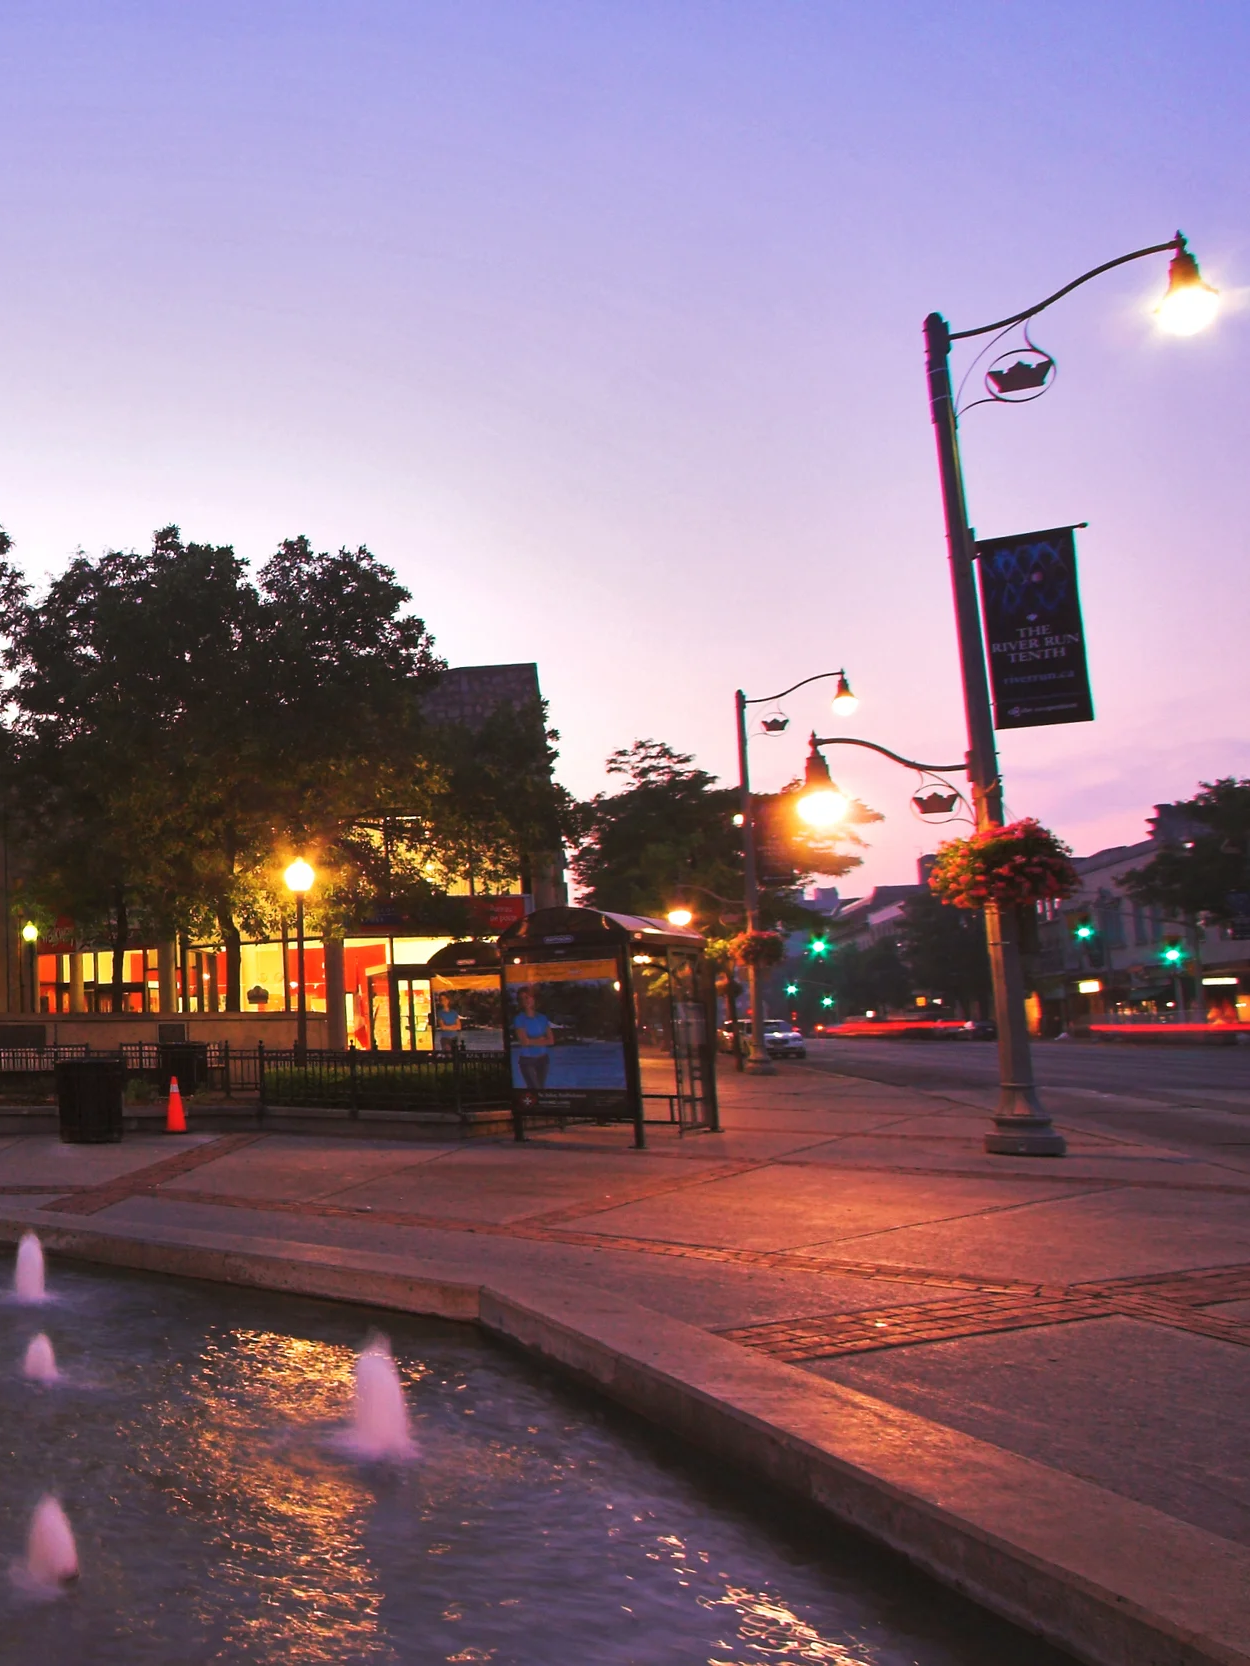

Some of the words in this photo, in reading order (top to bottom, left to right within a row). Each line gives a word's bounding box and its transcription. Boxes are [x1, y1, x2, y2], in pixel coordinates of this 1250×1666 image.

[1015, 624, 1052, 638] THE
[992, 638, 1040, 653] RIVER
[1044, 633, 1080, 646] RUN
[1008, 646, 1066, 664] TENTH
[1004, 670, 1075, 685] riverrun.ca
